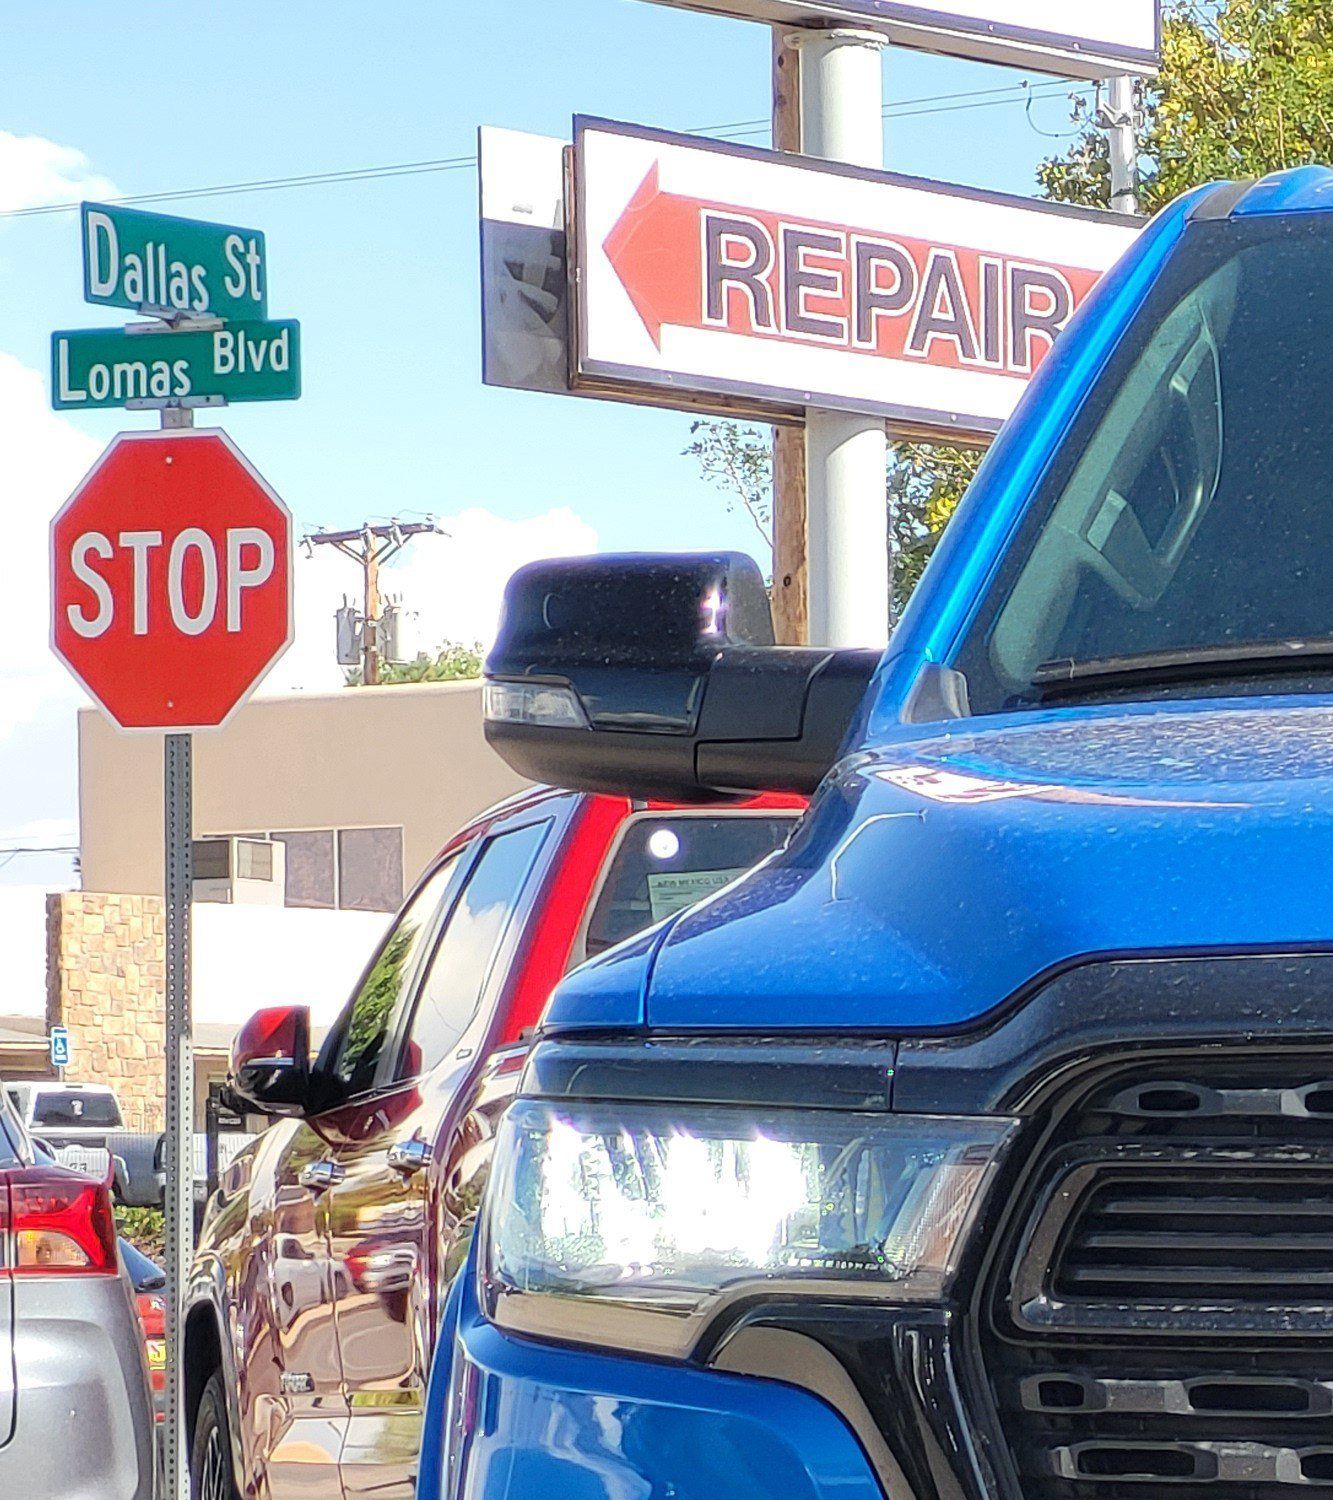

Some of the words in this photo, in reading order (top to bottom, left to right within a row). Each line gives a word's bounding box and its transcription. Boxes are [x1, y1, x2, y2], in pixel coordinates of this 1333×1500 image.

[87, 211, 209, 312] Dallas
[224, 234, 261, 301] St
[700, 208, 1074, 373] REPAIR
[58, 338, 191, 401] Lomas
[213, 328, 289, 375] Blvd
[67, 527, 275, 638] STOP
